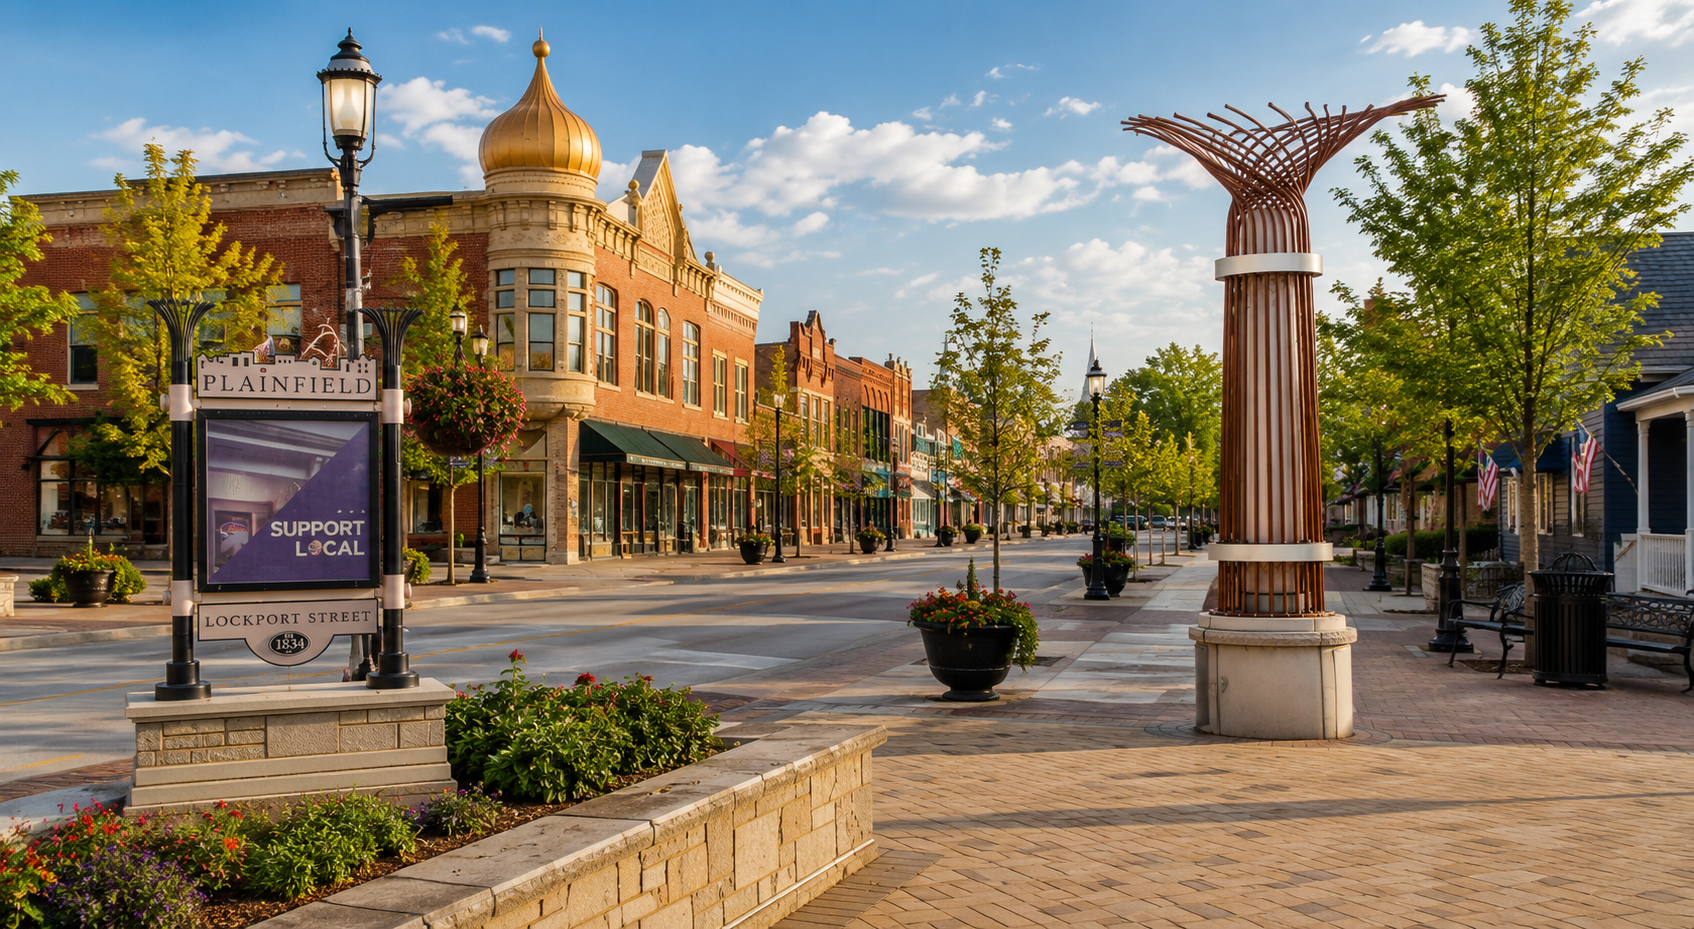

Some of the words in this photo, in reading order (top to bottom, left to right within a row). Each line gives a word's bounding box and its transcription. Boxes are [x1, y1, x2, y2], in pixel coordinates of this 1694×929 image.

[203, 374, 371, 394] PLAINFIELD
[270, 520, 365, 537] SUPPORT
[295, 540, 365, 556] LOCAL
[205, 613, 301, 628] LOCKPORT
[308, 611, 371, 624] STREET
[276, 638, 305, 650] 1834
